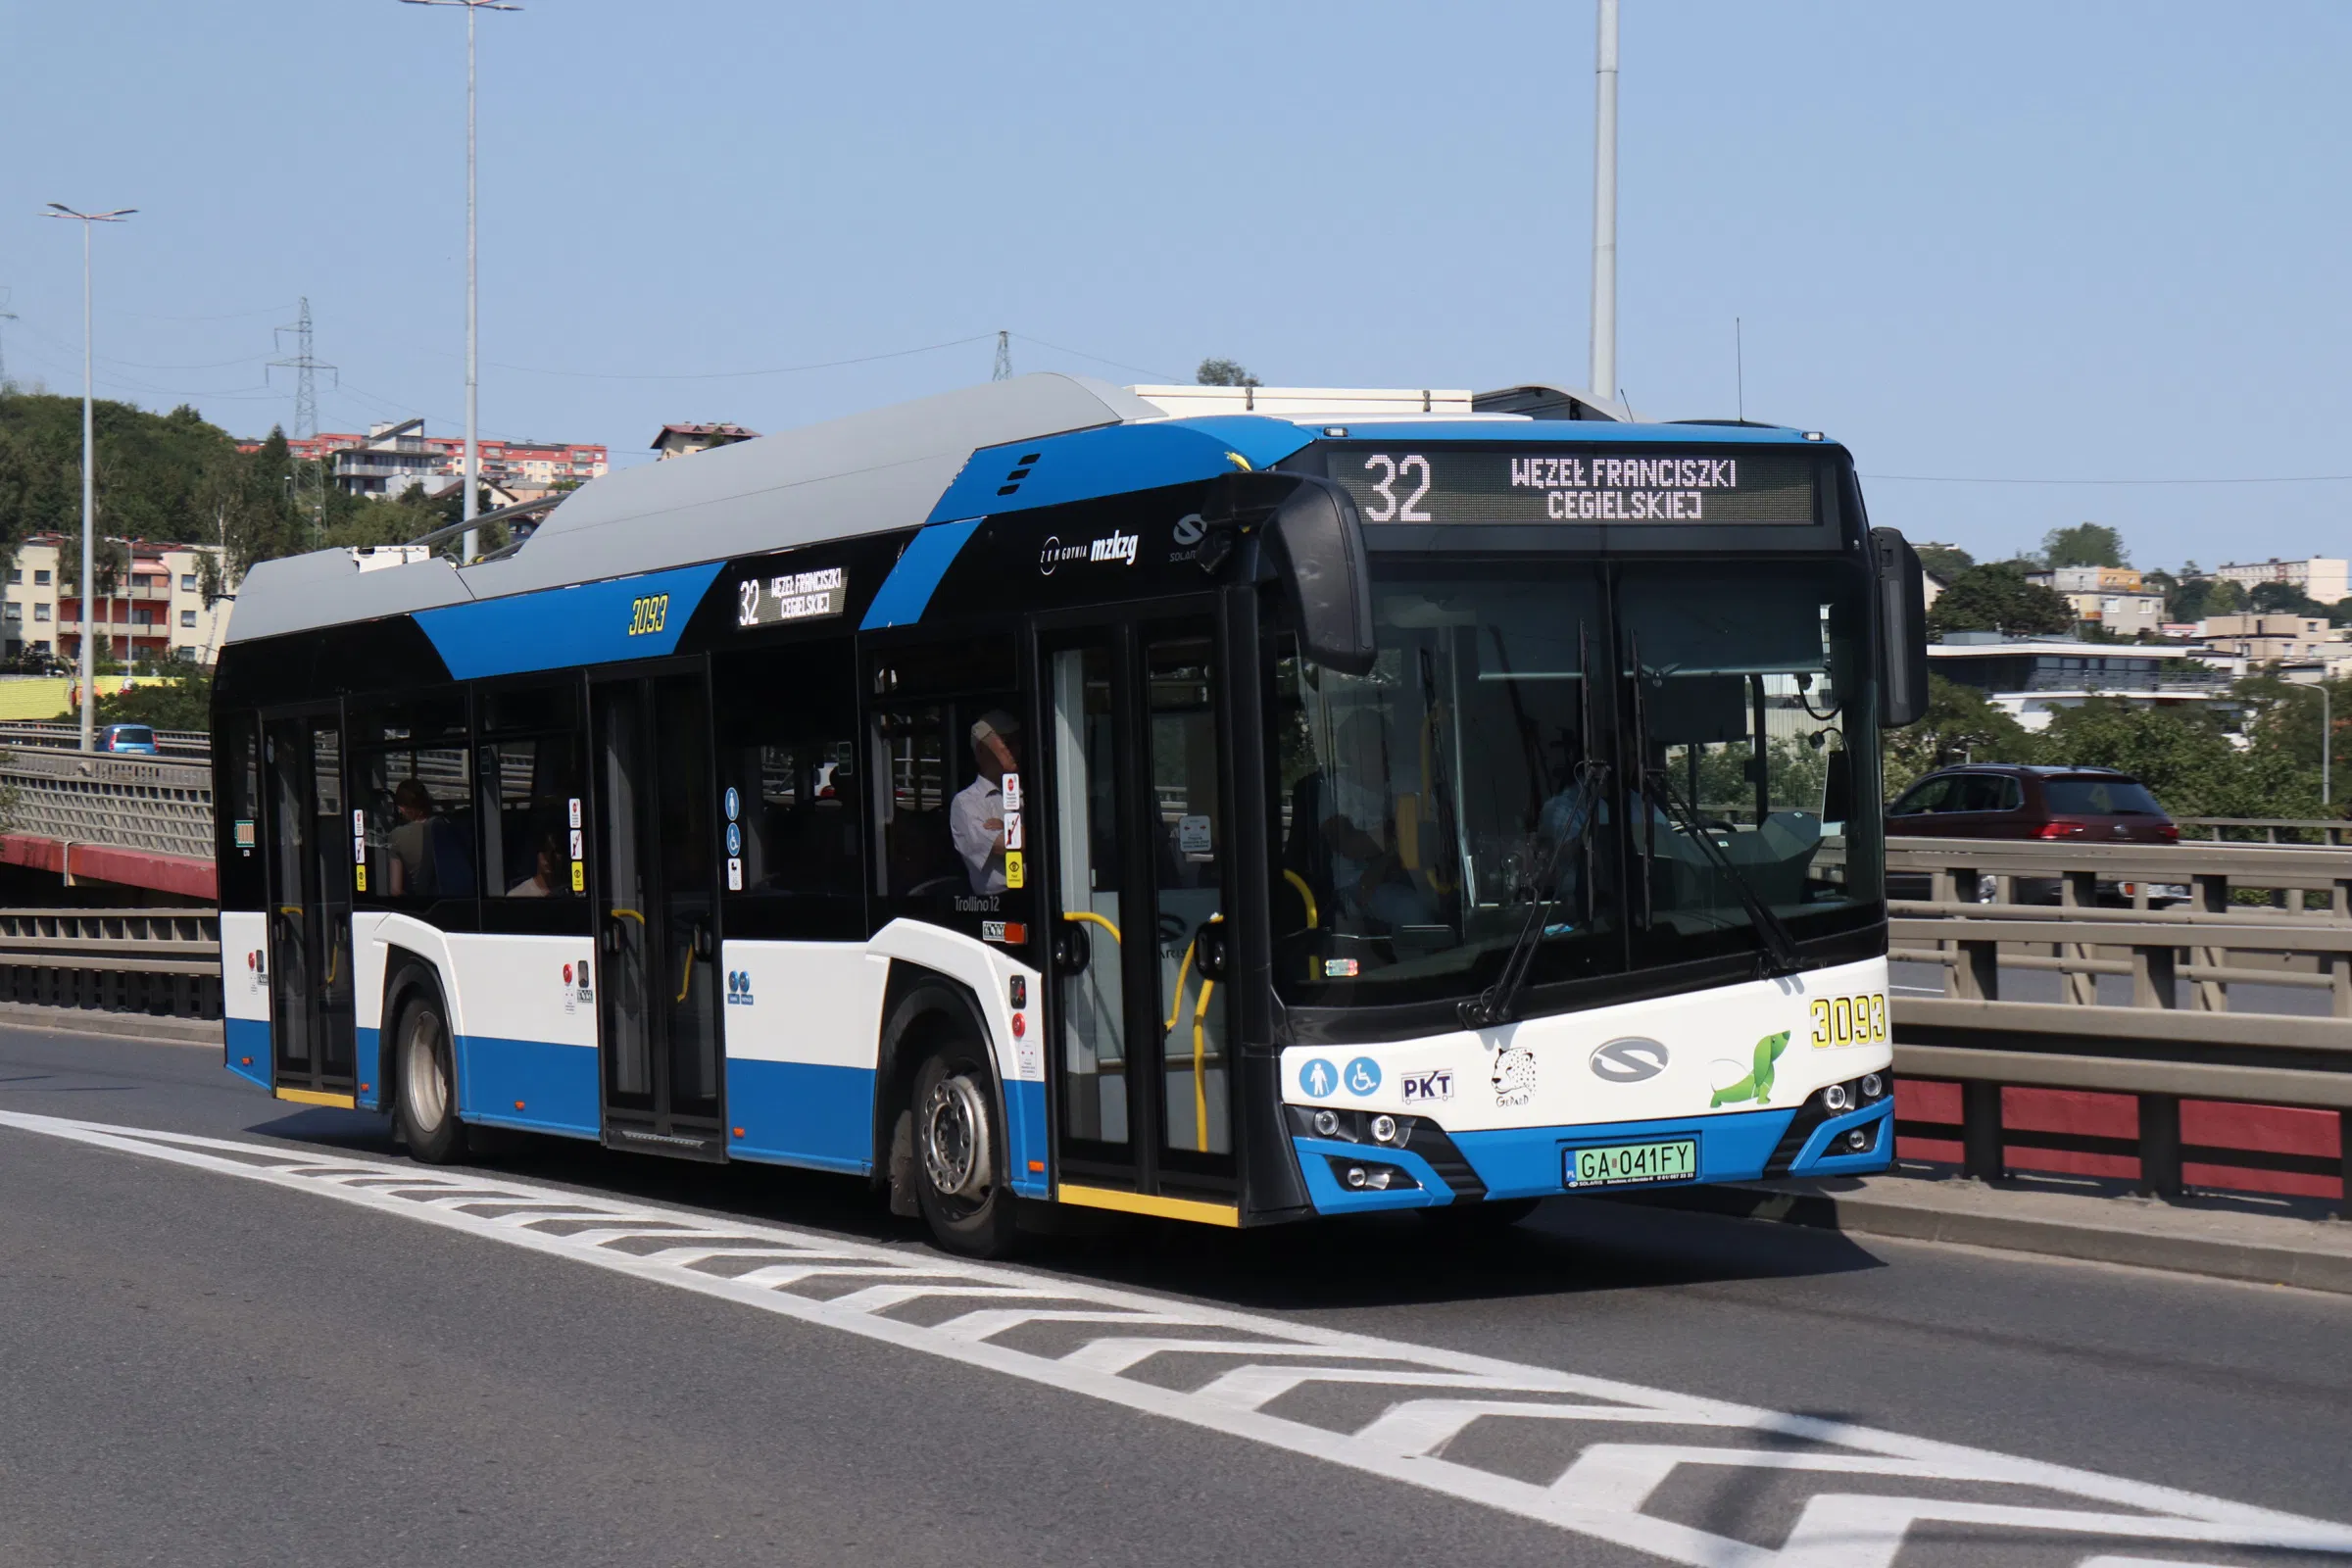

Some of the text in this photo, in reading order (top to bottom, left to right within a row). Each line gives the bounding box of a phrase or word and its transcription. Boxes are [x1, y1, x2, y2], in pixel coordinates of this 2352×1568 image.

[1365, 455, 1431, 521] 32
[1512, 459, 1736, 489] WĘZEŁ FRANCISZKI
[1547, 491, 1702, 519] CEGIELSKIEJ
[1061, 546, 1087, 561] GDYNIA
[1090, 529, 1139, 565] mzkzg
[1169, 550, 1197, 563] SOLAR
[795, 567, 842, 594] FRANCISZKI
[628, 593, 669, 636] 3093
[739, 579, 760, 625] 32
[781, 592, 830, 618] CEGIELSKIEJ
[954, 895, 1000, 912] Trollino 12
[1810, 994, 1886, 1049] 3093
[1403, 1070, 1450, 1099] PKT
[1582, 1145, 1689, 1178] GA 041FY
